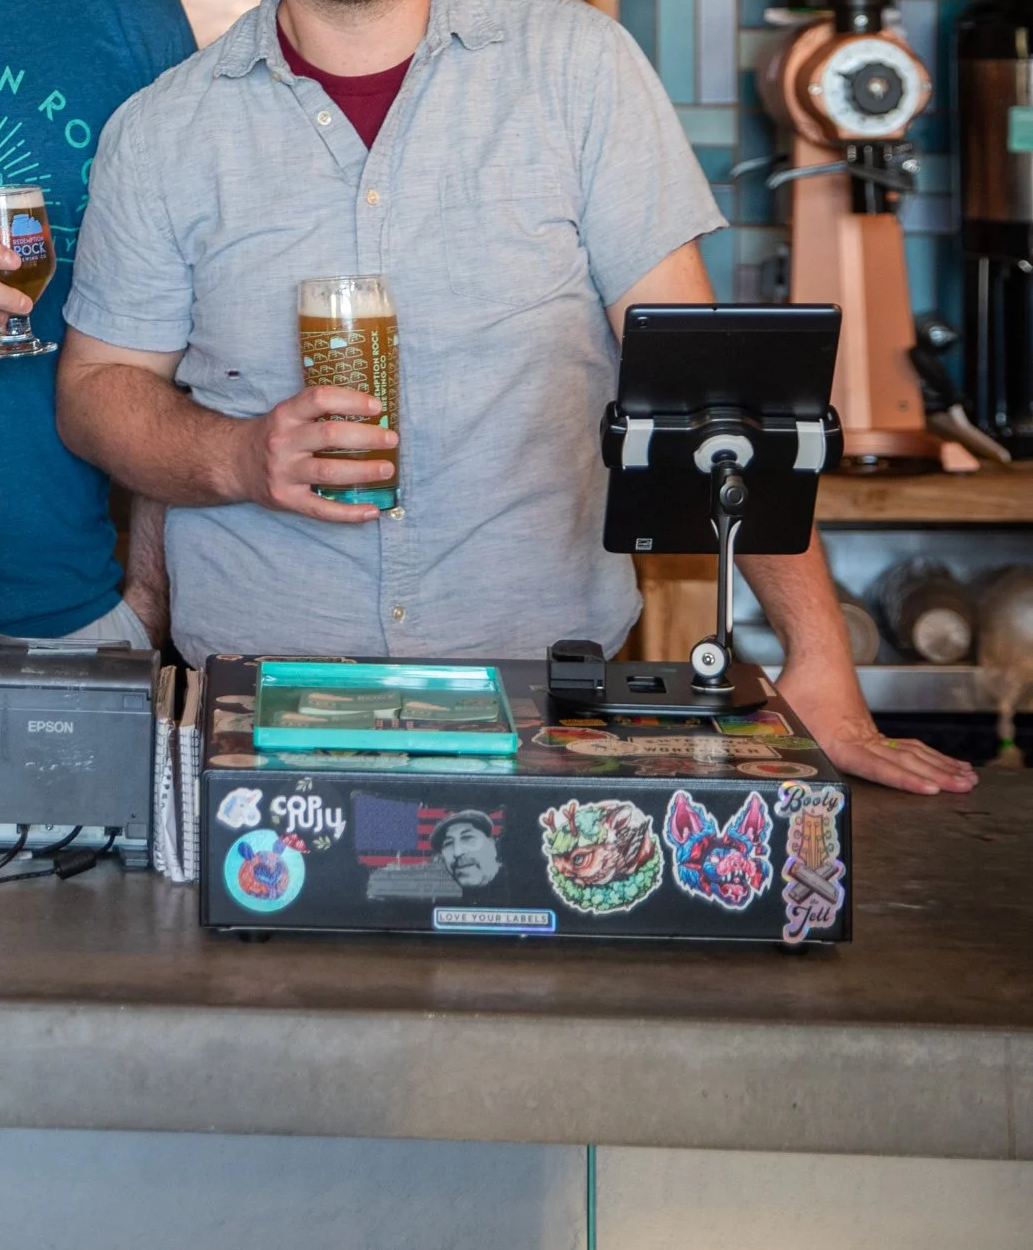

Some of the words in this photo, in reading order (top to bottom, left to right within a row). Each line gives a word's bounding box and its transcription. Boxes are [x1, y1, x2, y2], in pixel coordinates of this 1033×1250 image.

[12, 236, 45, 245] REDEMPTION
[13, 242, 46, 257] ROCK
[371, 330, 380, 356] ROCK
[372, 357, 381, 400] EMPTION
[380, 370, 388, 412] BREWING
[27, 720, 74, 734] EPSON
[780, 784, 839, 814] Booty
[439, 913, 467, 921] LOVE
[472, 913, 501, 922] YOUR
[507, 913, 547, 924] LABELS
